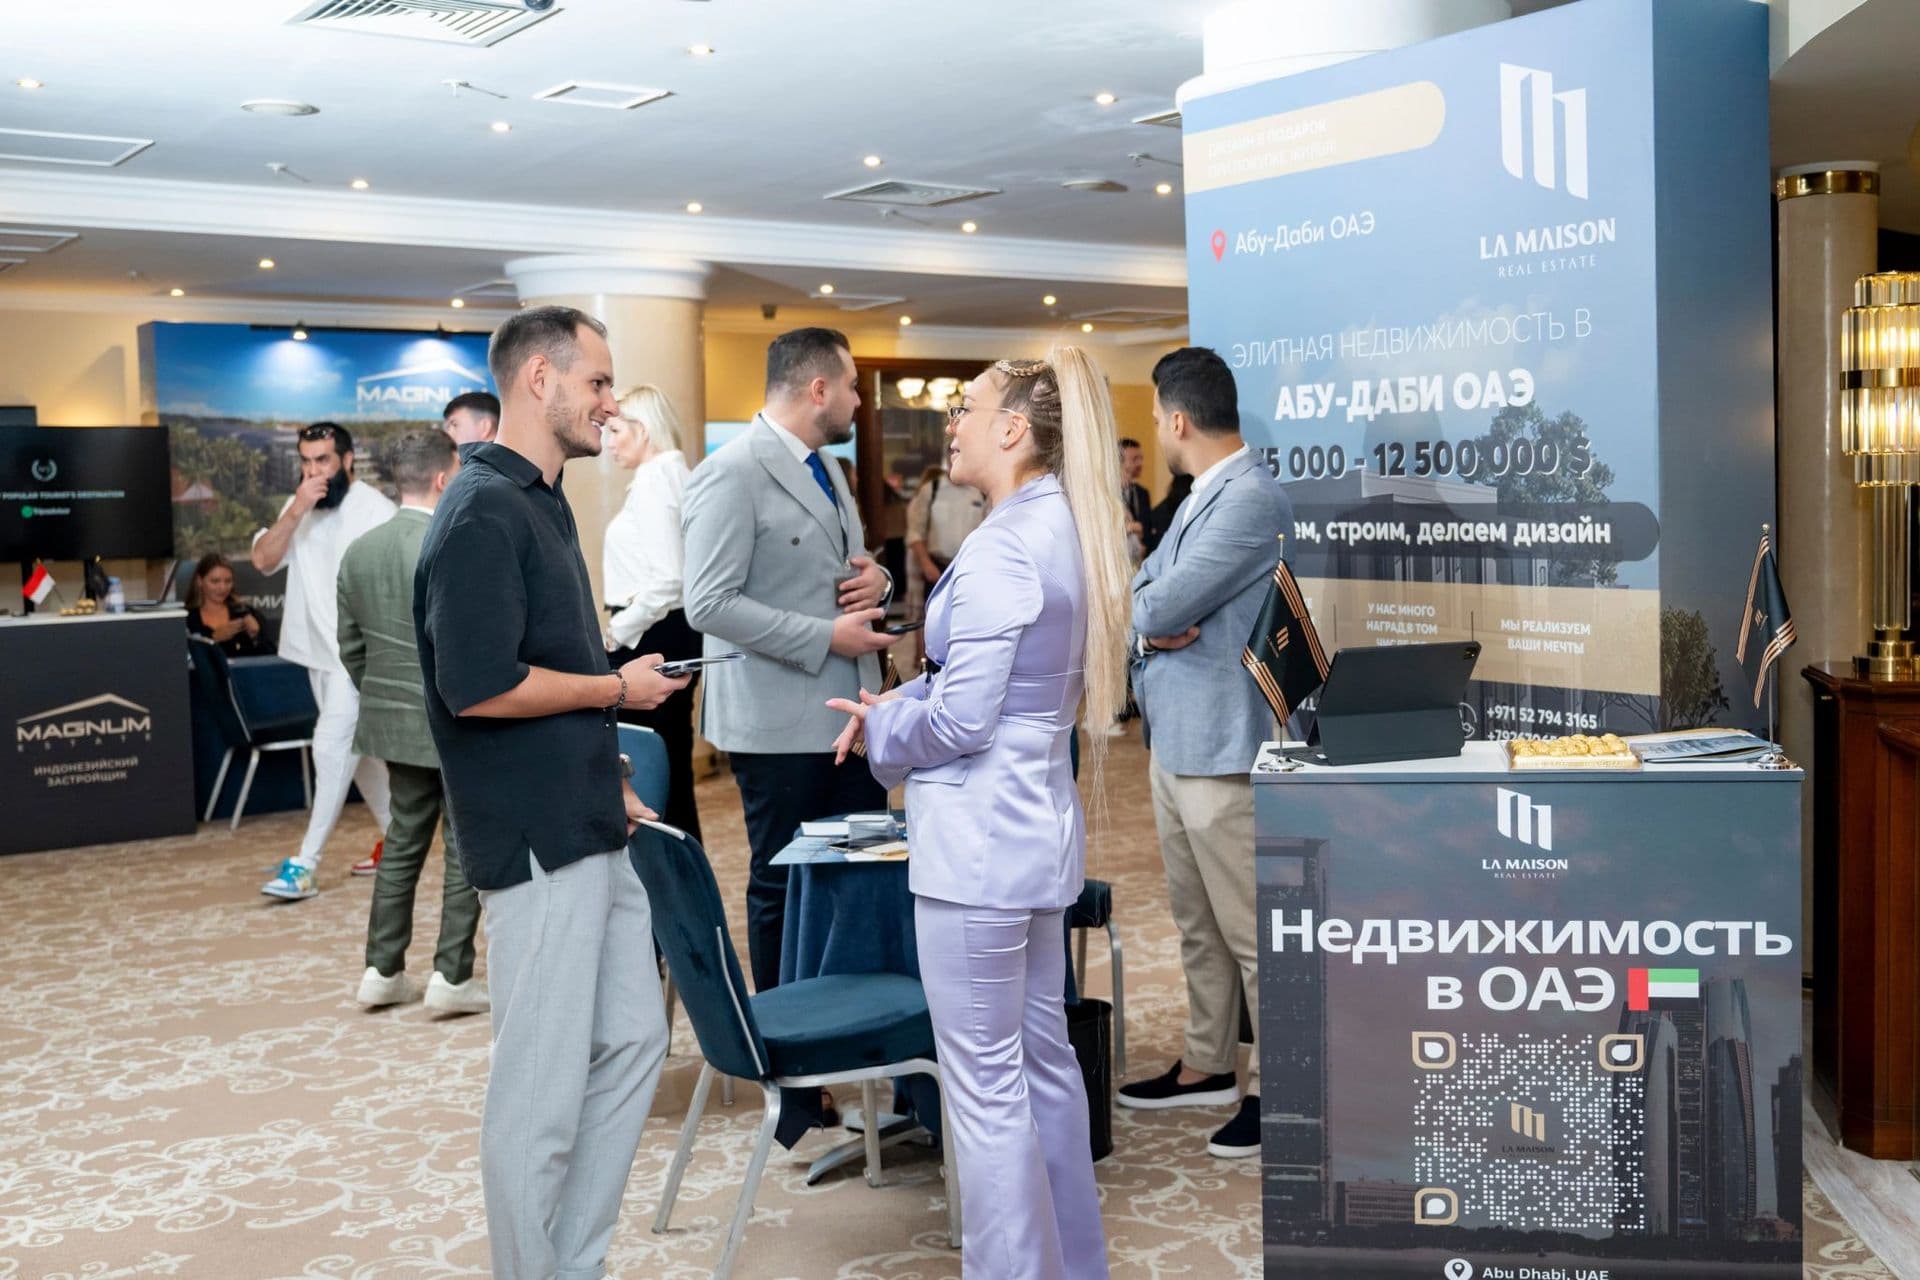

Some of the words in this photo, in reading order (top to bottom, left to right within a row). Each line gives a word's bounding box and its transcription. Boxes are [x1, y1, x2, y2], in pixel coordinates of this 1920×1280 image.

[1234, 220, 1325, 257] Абу-Даби
[1330, 210, 1375, 240] ОАЭ
[1479, 233, 1509, 260] LA
[1515, 217, 1616, 255] MAISON
[1498, 262, 1533, 278] REAL
[1541, 254, 1597, 273] ESTATE
[1231, 333, 1333, 369] ЭЛИТНАЯ
[1340, 311, 1566, 361] НЕДВИЖИМОСТЬ
[1574, 307, 1592, 338] В
[1274, 373, 1444, 423] АБУ-ДАБИ
[1452, 367, 1535, 410] ОАЭ
[1261, 446, 1281, 481] 5
[1288, 444, 1347, 480] 000
[1374, 442, 1407, 478] 12
[1414, 439, 1478, 478] 500
[1484, 437, 1560, 476] 000
[1568, 432, 1593, 480] $
[1325, 521, 1411, 547] строим,
[1416, 521, 1507, 546] делаем
[1512, 515, 1611, 547] дизайн
[1367, 602, 1375, 614] У
[1376, 603, 1397, 615] НАС
[1398, 604, 1436, 617] МНОГО
[1415, 623, 1438, 635] ТОМ
[1501, 619, 1520, 631] МЫ
[1522, 620, 1591, 636] РЕАЛИЗУЕМ
[1508, 638, 1540, 651] ВАШИ
[1543, 640, 1585, 655] МЕЧТЫ
[16, 715, 151, 742] MAGNUM
[1487, 705, 1516, 721] +971
[1519, 707, 1536, 723] 52
[1538, 709, 1562, 726] 794
[1565, 712, 1598, 729] 3165
[34, 755, 139, 776] ИНДОНЕЗИЙСКИЙ
[47, 769, 128, 788] ЗАСТРОЙЩИК
[1482, 859, 1501, 870] LA
[1505, 859, 1568, 870] MAISON
[1271, 909, 1793, 964] Недвижимость
[1427, 975, 1464, 1010] в
[1478, 966, 1616, 1012] ОАЭ
[1502, 1145, 1513, 1153] LA
[1516, 1145, 1555, 1153] MAISON
[1482, 1267, 1514, 1280] Abu
[1519, 1268, 1570, 1280] Dhabi,
[1575, 1269, 1609, 1280] UAE
